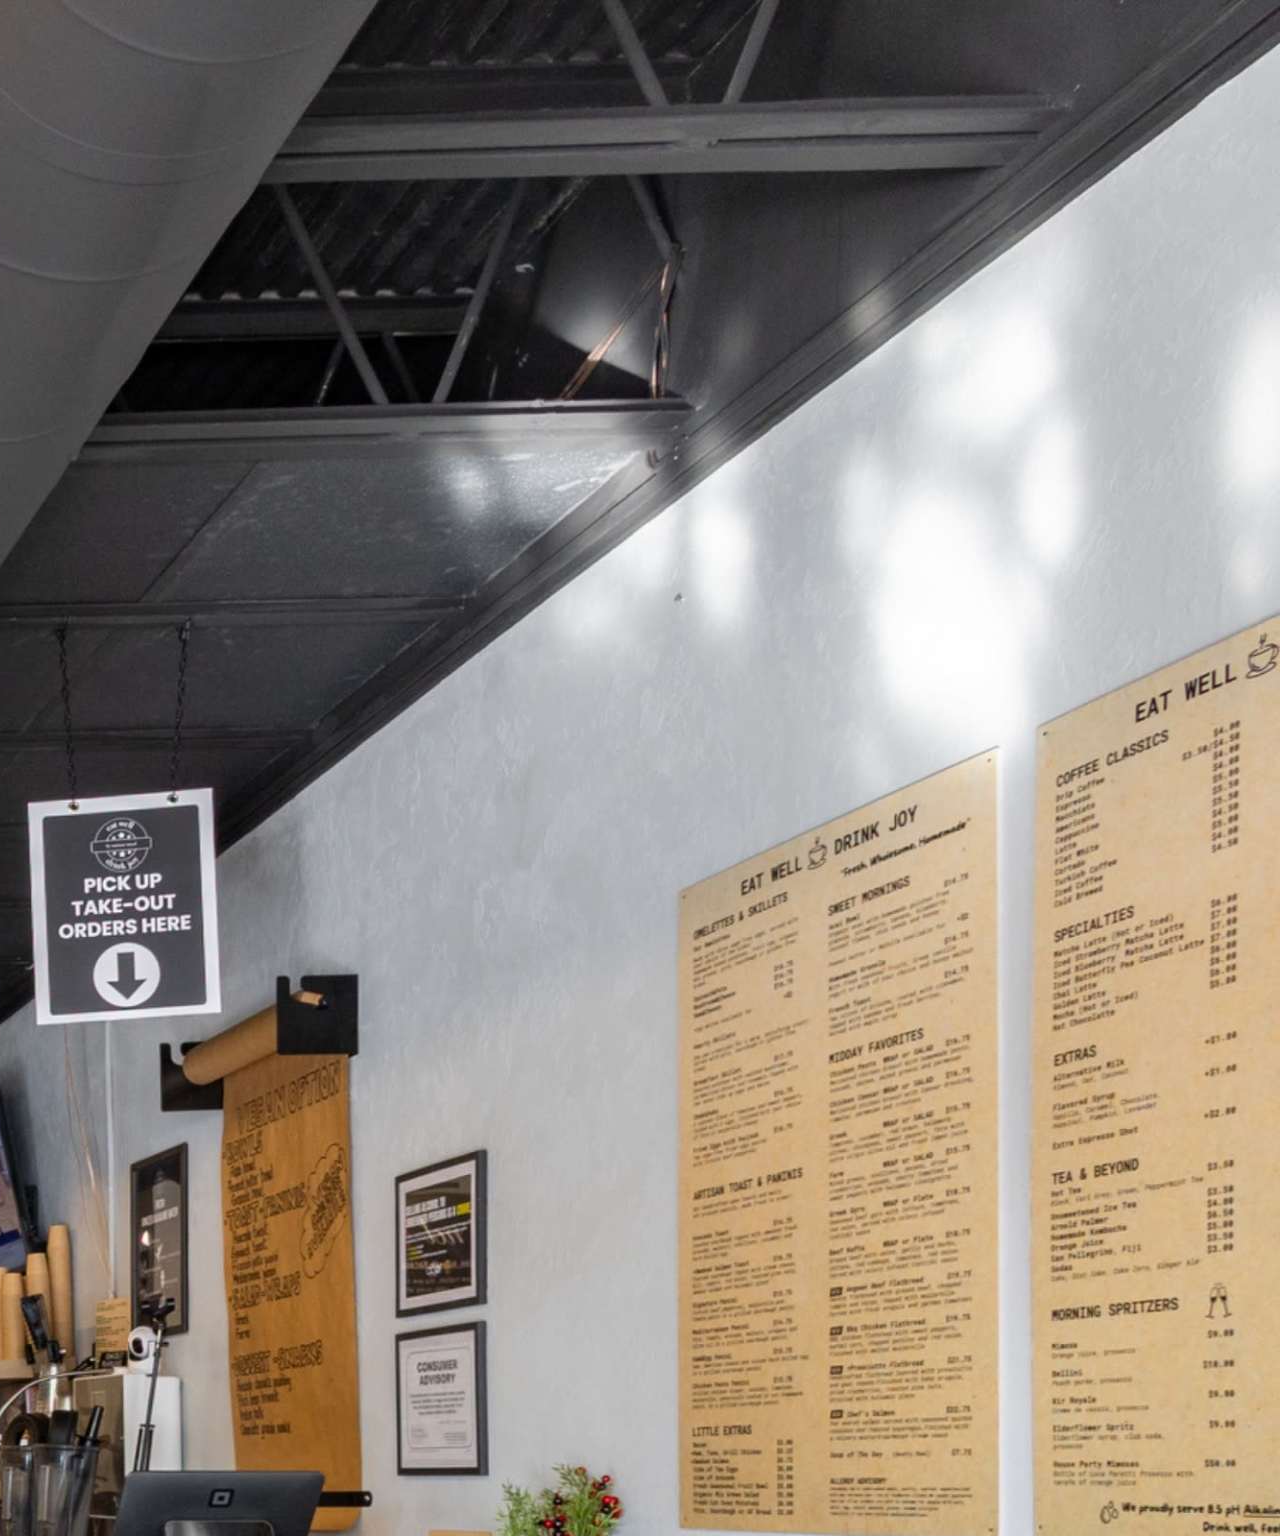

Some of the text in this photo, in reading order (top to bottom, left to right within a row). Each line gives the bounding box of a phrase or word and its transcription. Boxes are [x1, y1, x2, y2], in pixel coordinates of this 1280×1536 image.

[1135, 663, 1236, 723] EAT WELL
[1056, 729, 1168, 787] COFFEE CLASSICS
[834, 804, 917, 855] DRINK JOY
[84, 873, 162, 893] PICK UP
[741, 856, 801, 895] EAT WELL
[71, 894, 176, 916] TAKE-OUT
[748, 891, 787, 917] SKILLETS
[828, 875, 909, 916] SWEET MORNINGS
[59, 915, 191, 939] ORDERS HERE
[1054, 905, 1133, 943] SPECIALTIES
[829, 1027, 923, 1063] MIDDAY FAVORITES
[1054, 1044, 1096, 1066] EXTRAS
[1052, 1157, 1138, 1184] TEA & BEYOND
[729, 1178, 752, 1192] TOAST
[1052, 1297, 1178, 1320] MORNING SPRITZERS
[416, 1359, 458, 1373] CONSUMER
[419, 1373, 456, 1385] ADVISORY
[692, 1424, 751, 1437] LITTLE EXTRAS
[1122, 1502, 1135, 1511] We
[1139, 1503, 1173, 1515] proudly
[1177, 1505, 1203, 1513] serve
[1225, 1505, 1239, 1516] pH
[1203, 1521, 1230, 1532] Drink
[1234, 1523, 1256, 1533] well,
